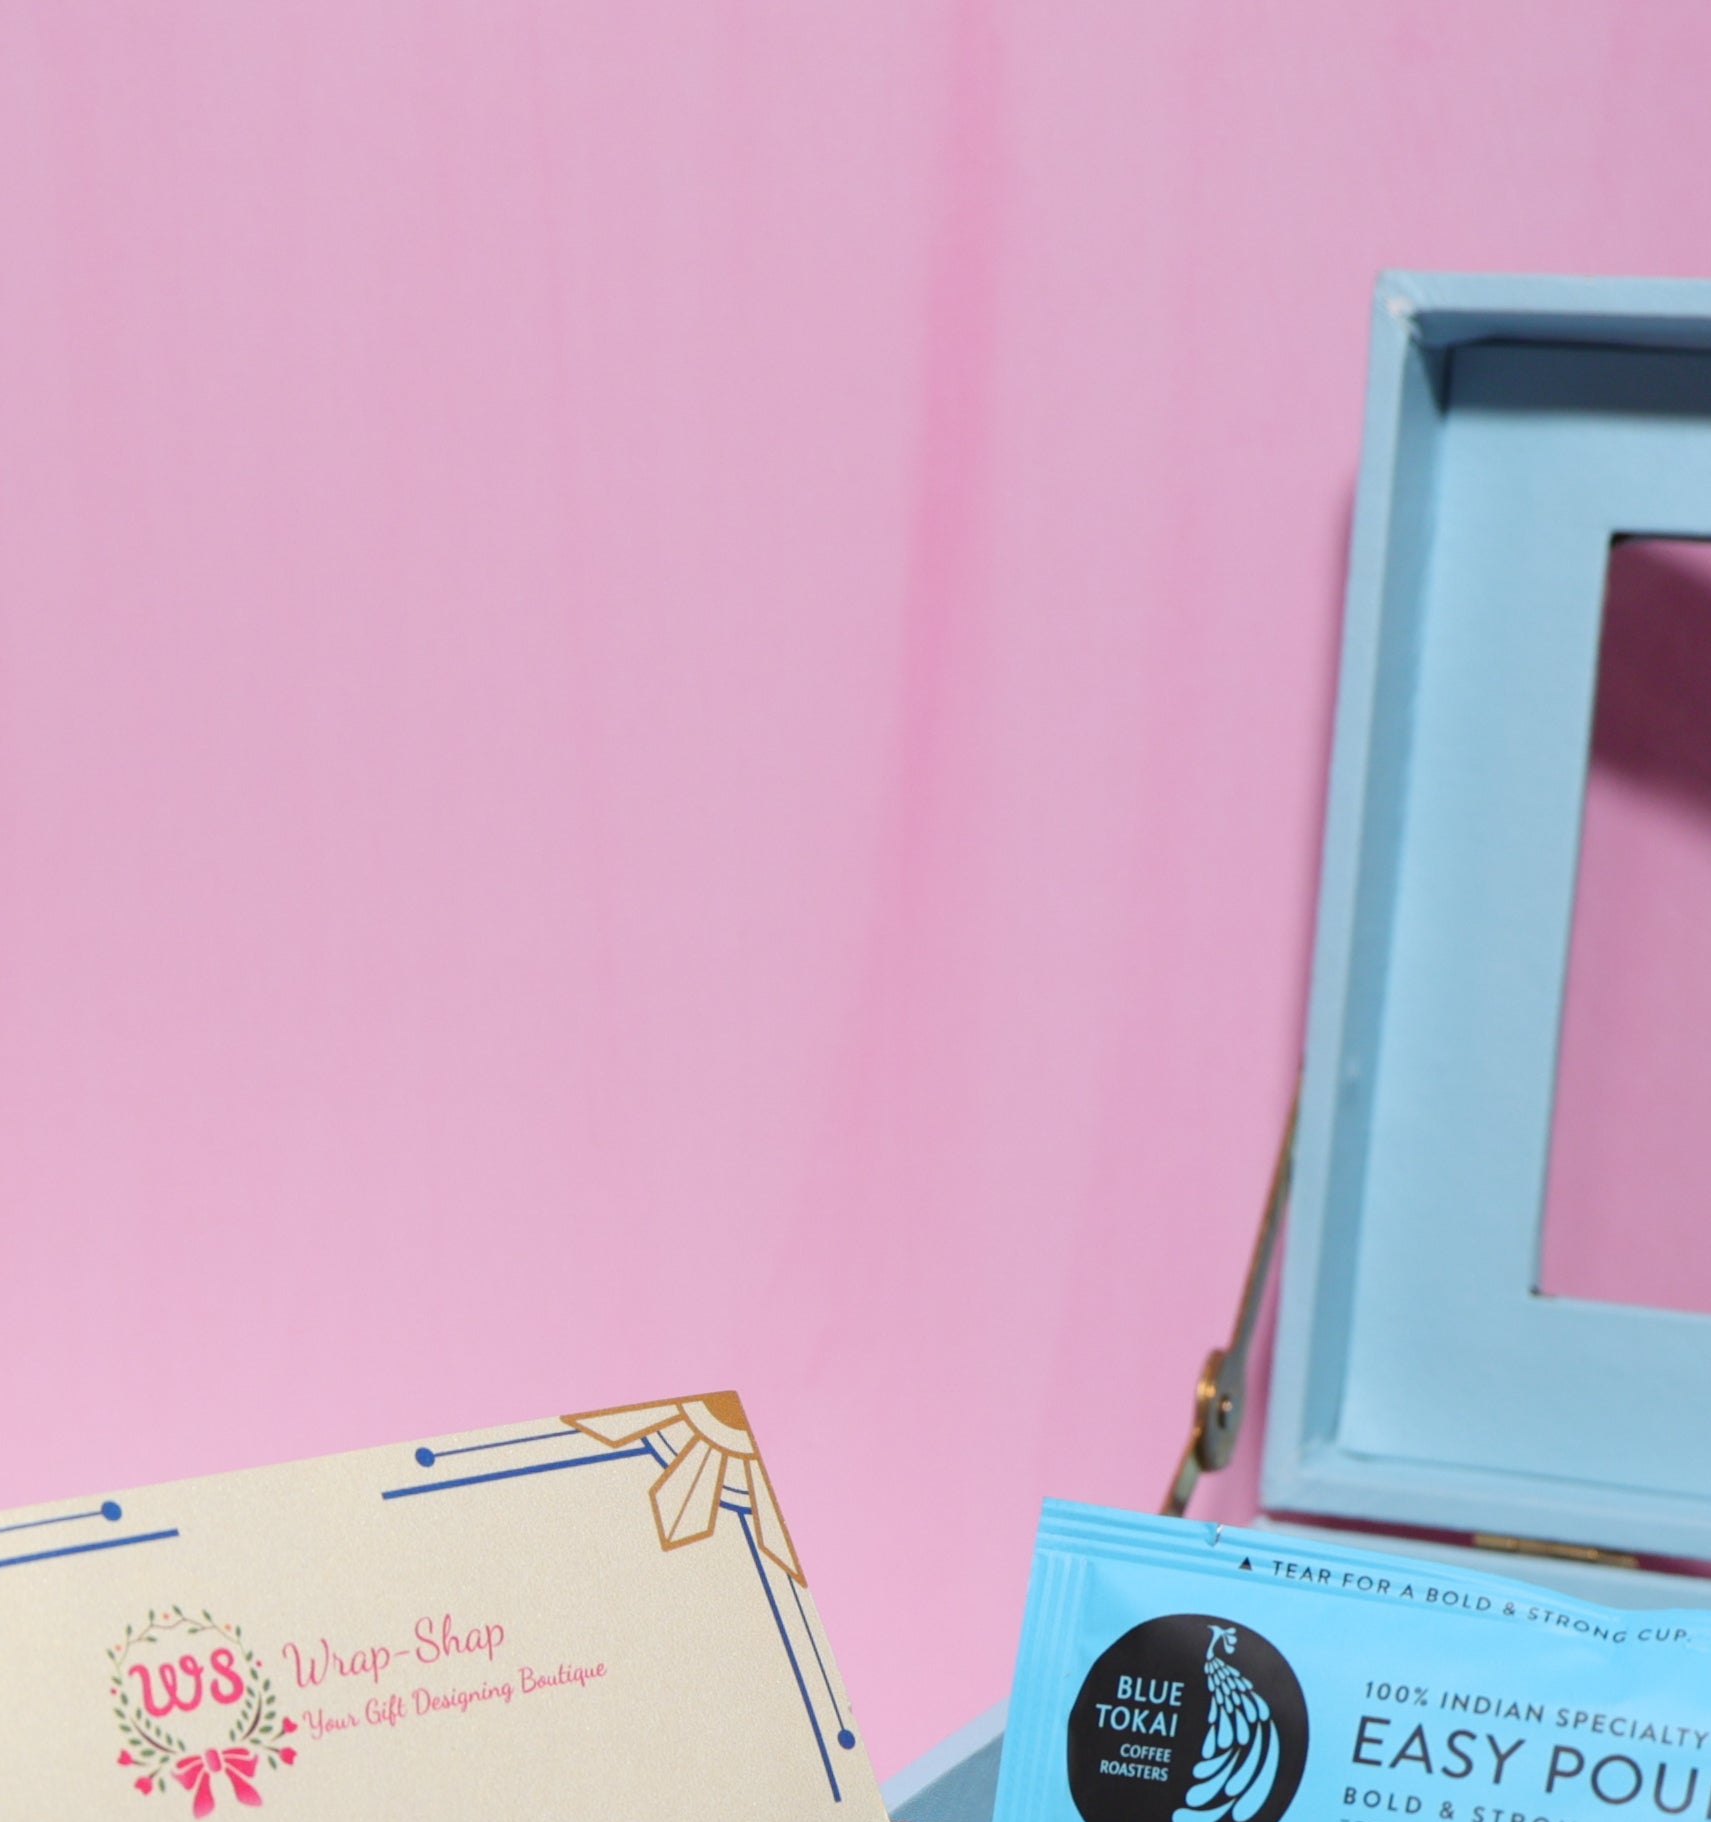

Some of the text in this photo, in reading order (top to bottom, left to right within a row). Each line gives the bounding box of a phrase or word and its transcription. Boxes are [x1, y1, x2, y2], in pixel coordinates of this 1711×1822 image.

[1272, 1560, 1332, 1585] TEAR
[1342, 1572, 1391, 1596] FOR
[1400, 1583, 1415, 1600] A
[1425, 1587, 1492, 1613] BOLD
[1502, 1602, 1517, 1616] &
[1527, 1607, 1629, 1645] STRONG
[282, 1612, 505, 1689] Wrap-Shap
[302, 1659, 608, 1740] Your Gift Designing Boutique
[1116, 1675, 1185, 1707] BLUE
[1364, 1680, 1430, 1708] 100%
[1439, 1690, 1546, 1724] INDIAN
[1555, 1707, 1711, 1752] SPECIALTY
[1095, 1703, 1178, 1738] TOKAI
[1099, 1759, 1169, 1782] ROASTERS
[1119, 1743, 1173, 1764] COFFEE
[1350, 1715, 1527, 1786] EASY
[1342, 1786, 1424, 1815] BOLD
[1438, 1800, 1456, 1820] &
